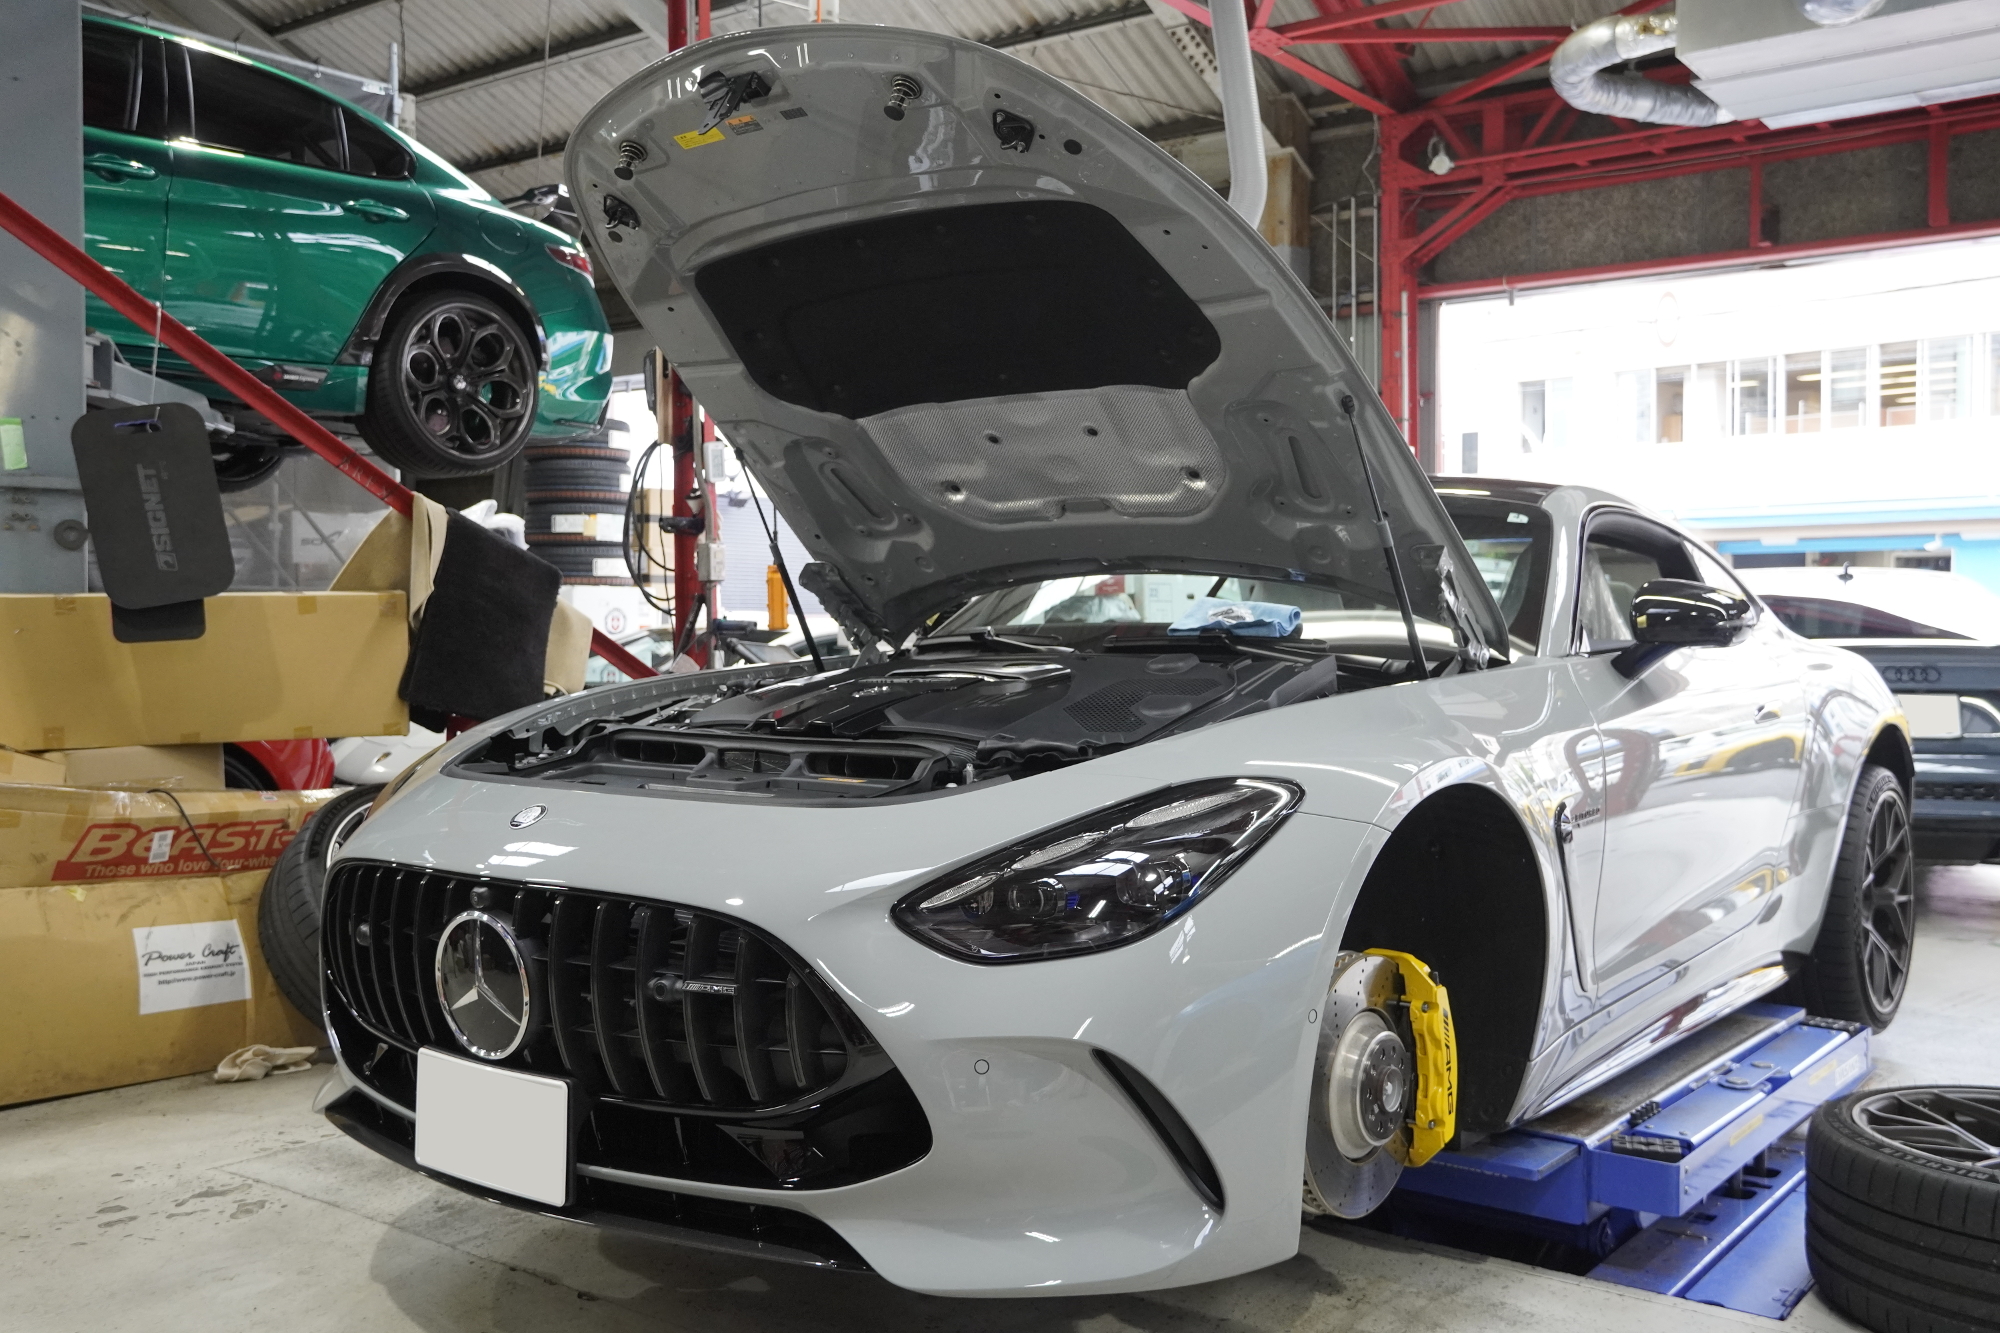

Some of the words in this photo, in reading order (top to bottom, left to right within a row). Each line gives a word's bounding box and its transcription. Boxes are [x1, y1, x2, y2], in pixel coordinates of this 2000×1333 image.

[136, 463, 173, 551] SIGNET
[85, 864, 136, 878] Those
[141, 862, 174, 875] who
[178, 858, 210, 872] love
[142, 950, 195, 966] Power
[201, 942, 239, 963] Craft
[699, 985, 735, 994] AMG
[1444, 1043, 1454, 1115] AMG
[1880, 1148, 1989, 1180] MICHELIN
